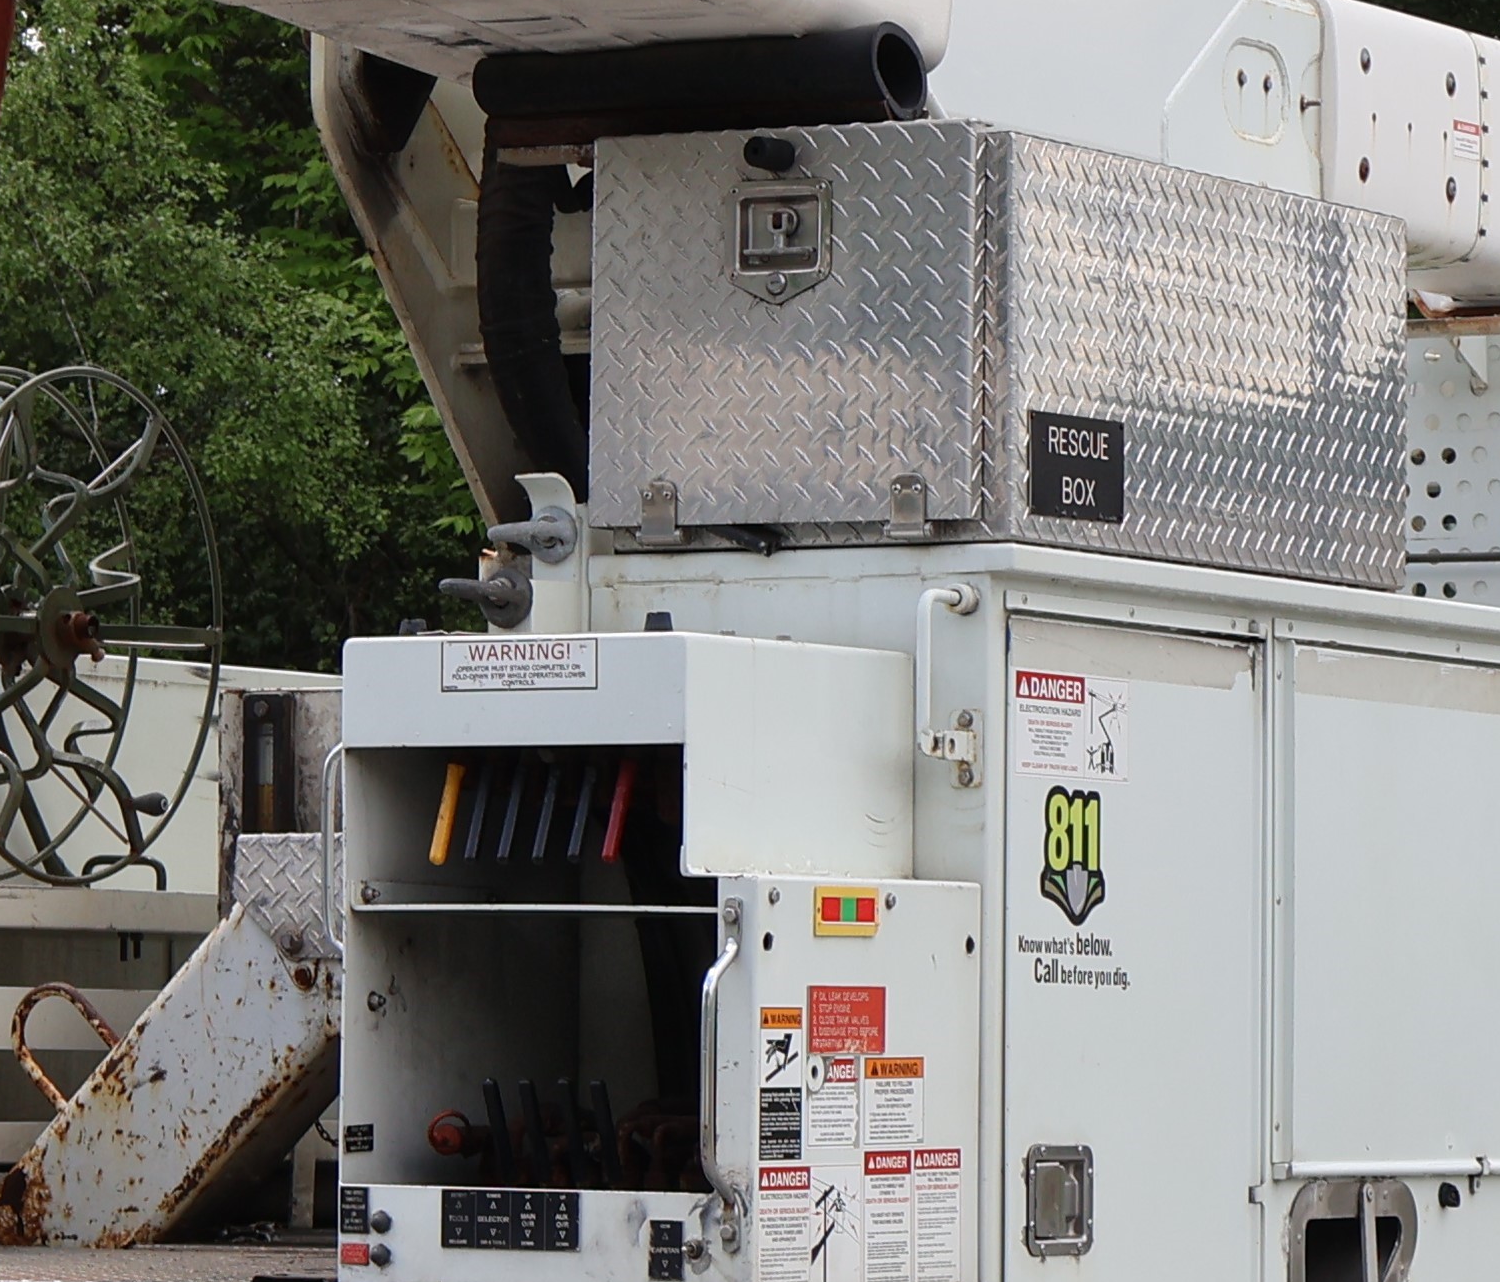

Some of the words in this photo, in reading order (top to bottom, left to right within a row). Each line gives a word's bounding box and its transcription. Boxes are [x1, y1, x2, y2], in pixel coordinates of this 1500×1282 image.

[1048, 425, 1109, 461] RESCUE
[1062, 476, 1096, 507] BOX
[468, 643, 571, 662] WARNING!
[1031, 677, 1082, 702] DANGER
[1019, 704, 1060, 715] ELECTROCUTION
[1061, 708, 1082, 717] HAZARD
[1048, 793, 1099, 872] 811
[1018, 935, 1043, 953] Know
[1044, 935, 1075, 955] what's
[1076, 932, 1113, 956] below.
[1034, 957, 1059, 984] Call
[1061, 965, 1093, 985] before
[1094, 970, 1112, 989] you
[1112, 967, 1131, 990] dig.
[770, 1013, 801, 1025] WARNING
[827, 1064, 856, 1079] ANGER
[880, 1062, 919, 1076] WARNING
[876, 1155, 908, 1169] DANGER
[923, 1153, 959, 1167] DANGER
[770, 1172, 809, 1187] DANGER
